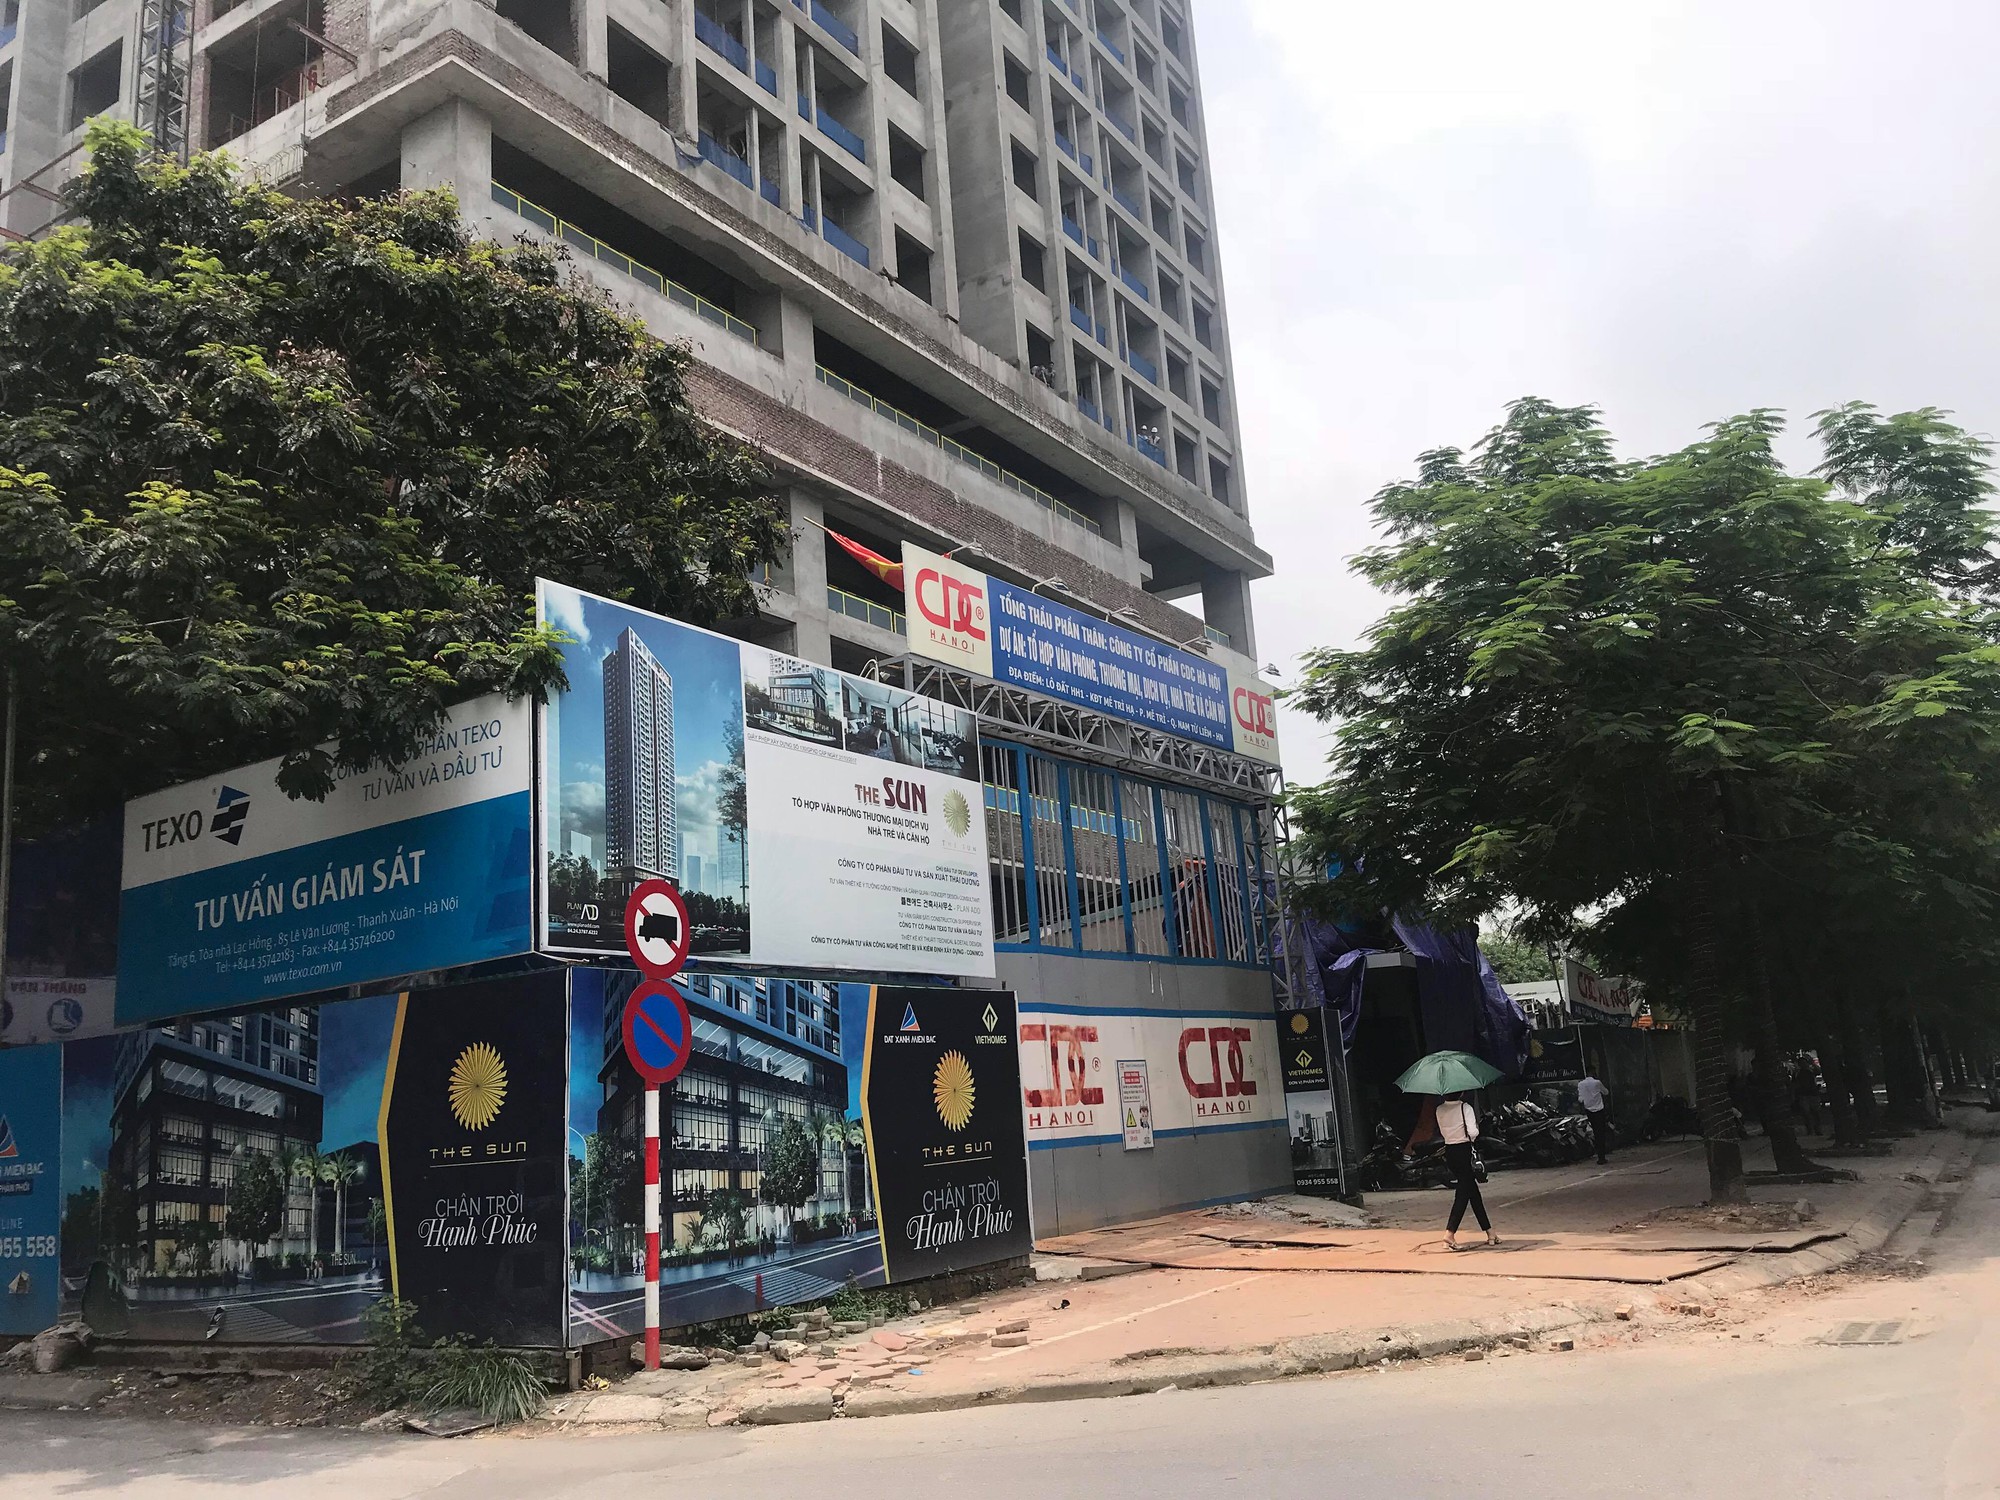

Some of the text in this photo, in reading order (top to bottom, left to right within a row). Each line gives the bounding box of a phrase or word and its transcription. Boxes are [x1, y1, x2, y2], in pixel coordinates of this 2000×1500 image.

[930, 629, 974, 652] HANOI
[999, 591, 1221, 694] TỔNG THẦU PHẦN THÂN: CÔNG TY CỔ PHẦN CDC HÀ NỘI
[999, 626, 1011, 658] DỰ
[1013, 626, 1027, 658] ÁN:
[1027, 629, 1038, 662] TỔ
[1038, 639, 1054, 671] HỢP
[1055, 643, 1071, 673] VĂN
[1099, 661, 1126, 693] THƯƠNG
[1143, 676, 1159, 705] DỊCH
[1170, 684, 1184, 711] NHÀ
[1184, 686, 1196, 714] TRẺ
[1196, 693, 1205, 718] VÀ
[1205, 696, 1217, 722] CĂN
[1217, 700, 1226, 729] HỘ
[1008, 666, 1022, 680] ĐỊA
[1046, 677, 1055, 689] LÔ
[1056, 681, 1069, 694] ĐẤT
[1071, 686, 1084, 699] HH1
[1090, 692, 1103, 705] KĐT
[1126, 704, 1135, 716] HẠ
[1178, 720, 1190, 731] NAM
[1216, 732, 1224, 742] HN
[462, 719, 502, 746] TEXO
[1244, 734, 1269, 748] HANOI
[363, 778, 382, 801] TƯ
[419, 762, 440, 786] VÀ
[443, 751, 477, 781] ĐẦU
[481, 746, 502, 771] TƯ
[855, 777, 927, 814] THE SUN
[141, 809, 203, 852] TEXO
[868, 825, 881, 837] NHÀ
[896, 830, 905, 841] VÀ
[838, 858, 855, 869] CÔNG
[857, 861, 865, 870] TY
[195, 845, 426, 931] TƯ VẤN GIÁM SÁT
[567, 902, 582, 910] PLAN
[278, 932, 289, 947] 85
[290, 928, 300, 942] Lê
[321, 921, 350, 936] Lương
[358, 910, 388, 929] Thanh
[389, 906, 415, 922] Xuân
[424, 900, 438, 915] Hà
[440, 896, 459, 912] Nội
[216, 929, 395, 974] Tel: 35742183 Fax: 35746200
[263, 961, 342, 984] www.texo.com.vn
[895, 1035, 910, 1044] XANH
[974, 1035, 1007, 1044] VIETHOMES
[1288, 1067, 1323, 1076] VIETHOMES
[1029, 1110, 1093, 1126] HANOI
[1197, 1100, 1251, 1114] HANOI
[429, 1146, 472, 1159] THE
[922, 1145, 956, 1158] THE
[435, 1189, 523, 1217] CHÂN TRỜI
[923, 1175, 1000, 1213] CHÂN TRỜI
[418, 1214, 537, 1252] Hạnh Phúc
[906, 1203, 1013, 1253] Hạnh Phúc
[26, 1235, 56, 1258] 558
